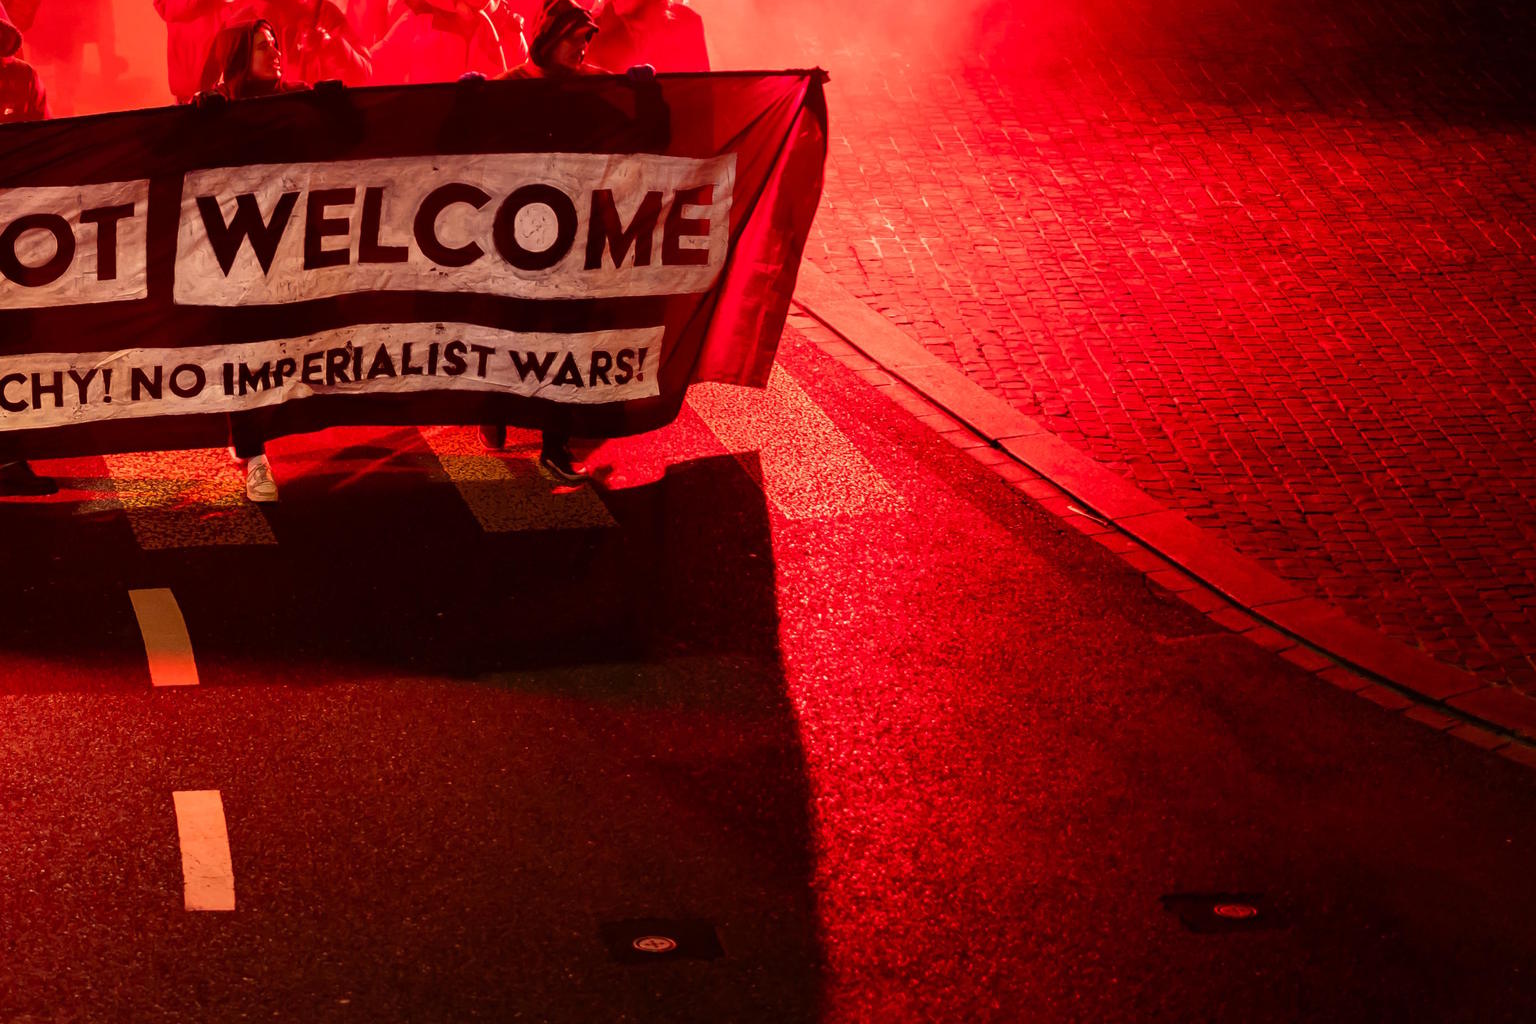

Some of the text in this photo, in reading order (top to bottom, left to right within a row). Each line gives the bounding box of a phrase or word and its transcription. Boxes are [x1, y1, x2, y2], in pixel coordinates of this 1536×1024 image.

[195, 182, 713, 278] WELCOME
[130, 363, 207, 401] NO
[223, 339, 496, 397] IMPERIALIST
[508, 346, 649, 388] WARS!
